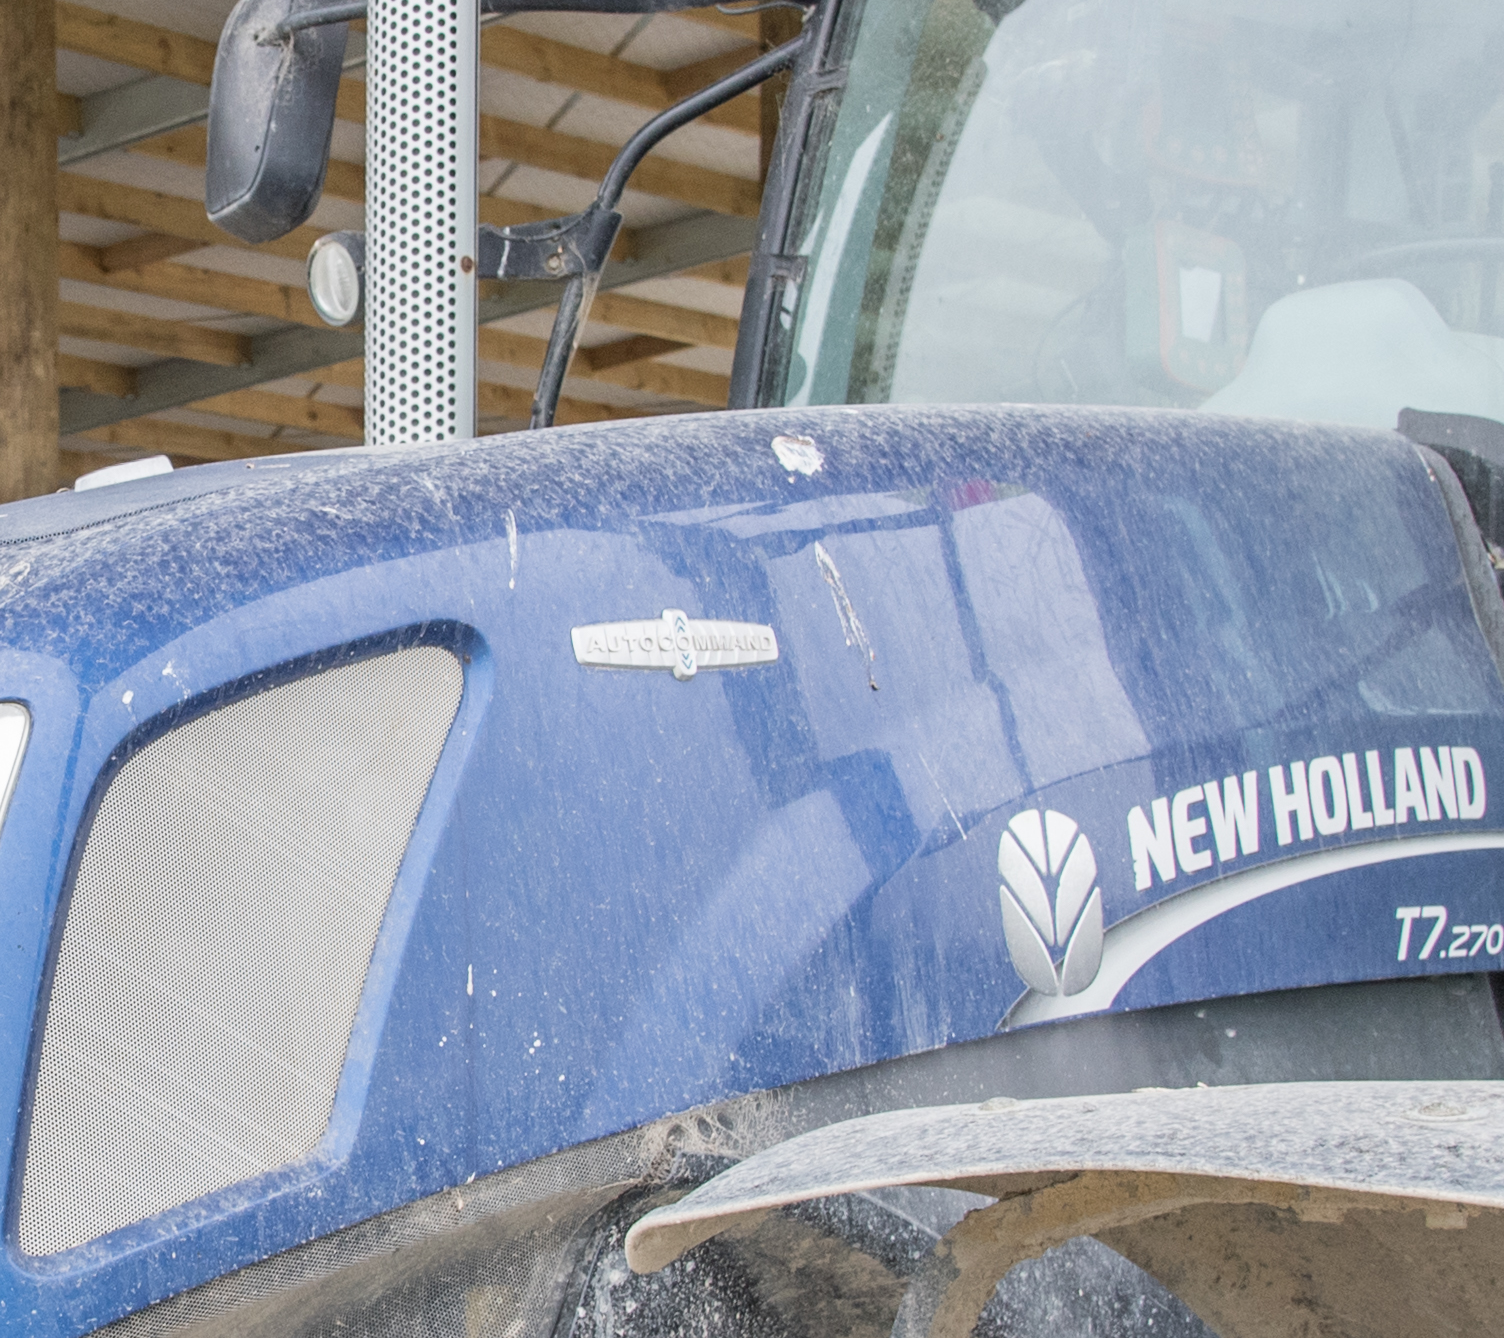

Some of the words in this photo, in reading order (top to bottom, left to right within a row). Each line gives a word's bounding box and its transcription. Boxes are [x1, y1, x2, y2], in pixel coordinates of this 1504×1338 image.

[586, 633, 775, 654] AUTOCOMMAND
[1126, 769, 1259, 892] NEW
[1268, 745, 1487, 848] HOLLAND
